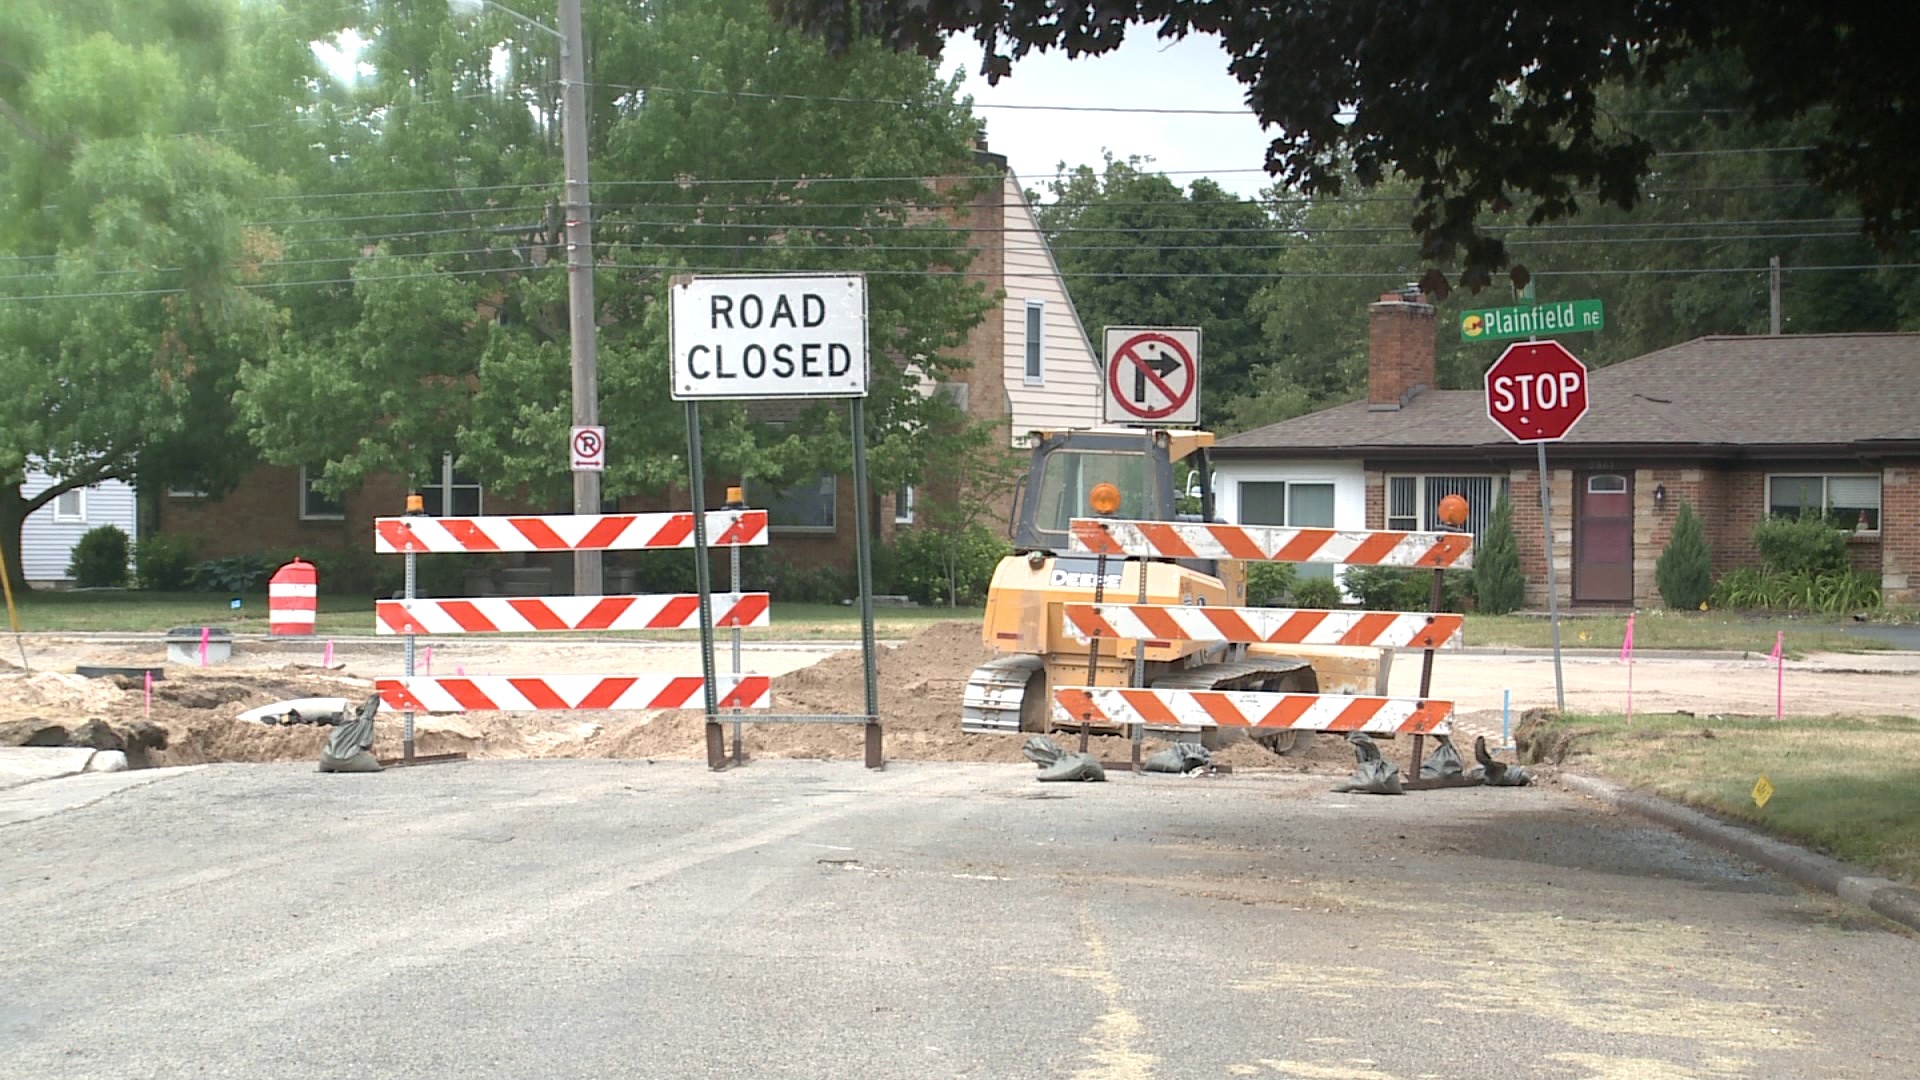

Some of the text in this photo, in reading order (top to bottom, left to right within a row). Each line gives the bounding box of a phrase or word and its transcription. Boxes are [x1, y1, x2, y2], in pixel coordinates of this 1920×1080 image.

[711, 294, 826, 329] ROAD
[1484, 303, 1575, 335] Plainfield
[687, 343, 851, 379] CLOSED
[1494, 372, 1581, 412] STOP
